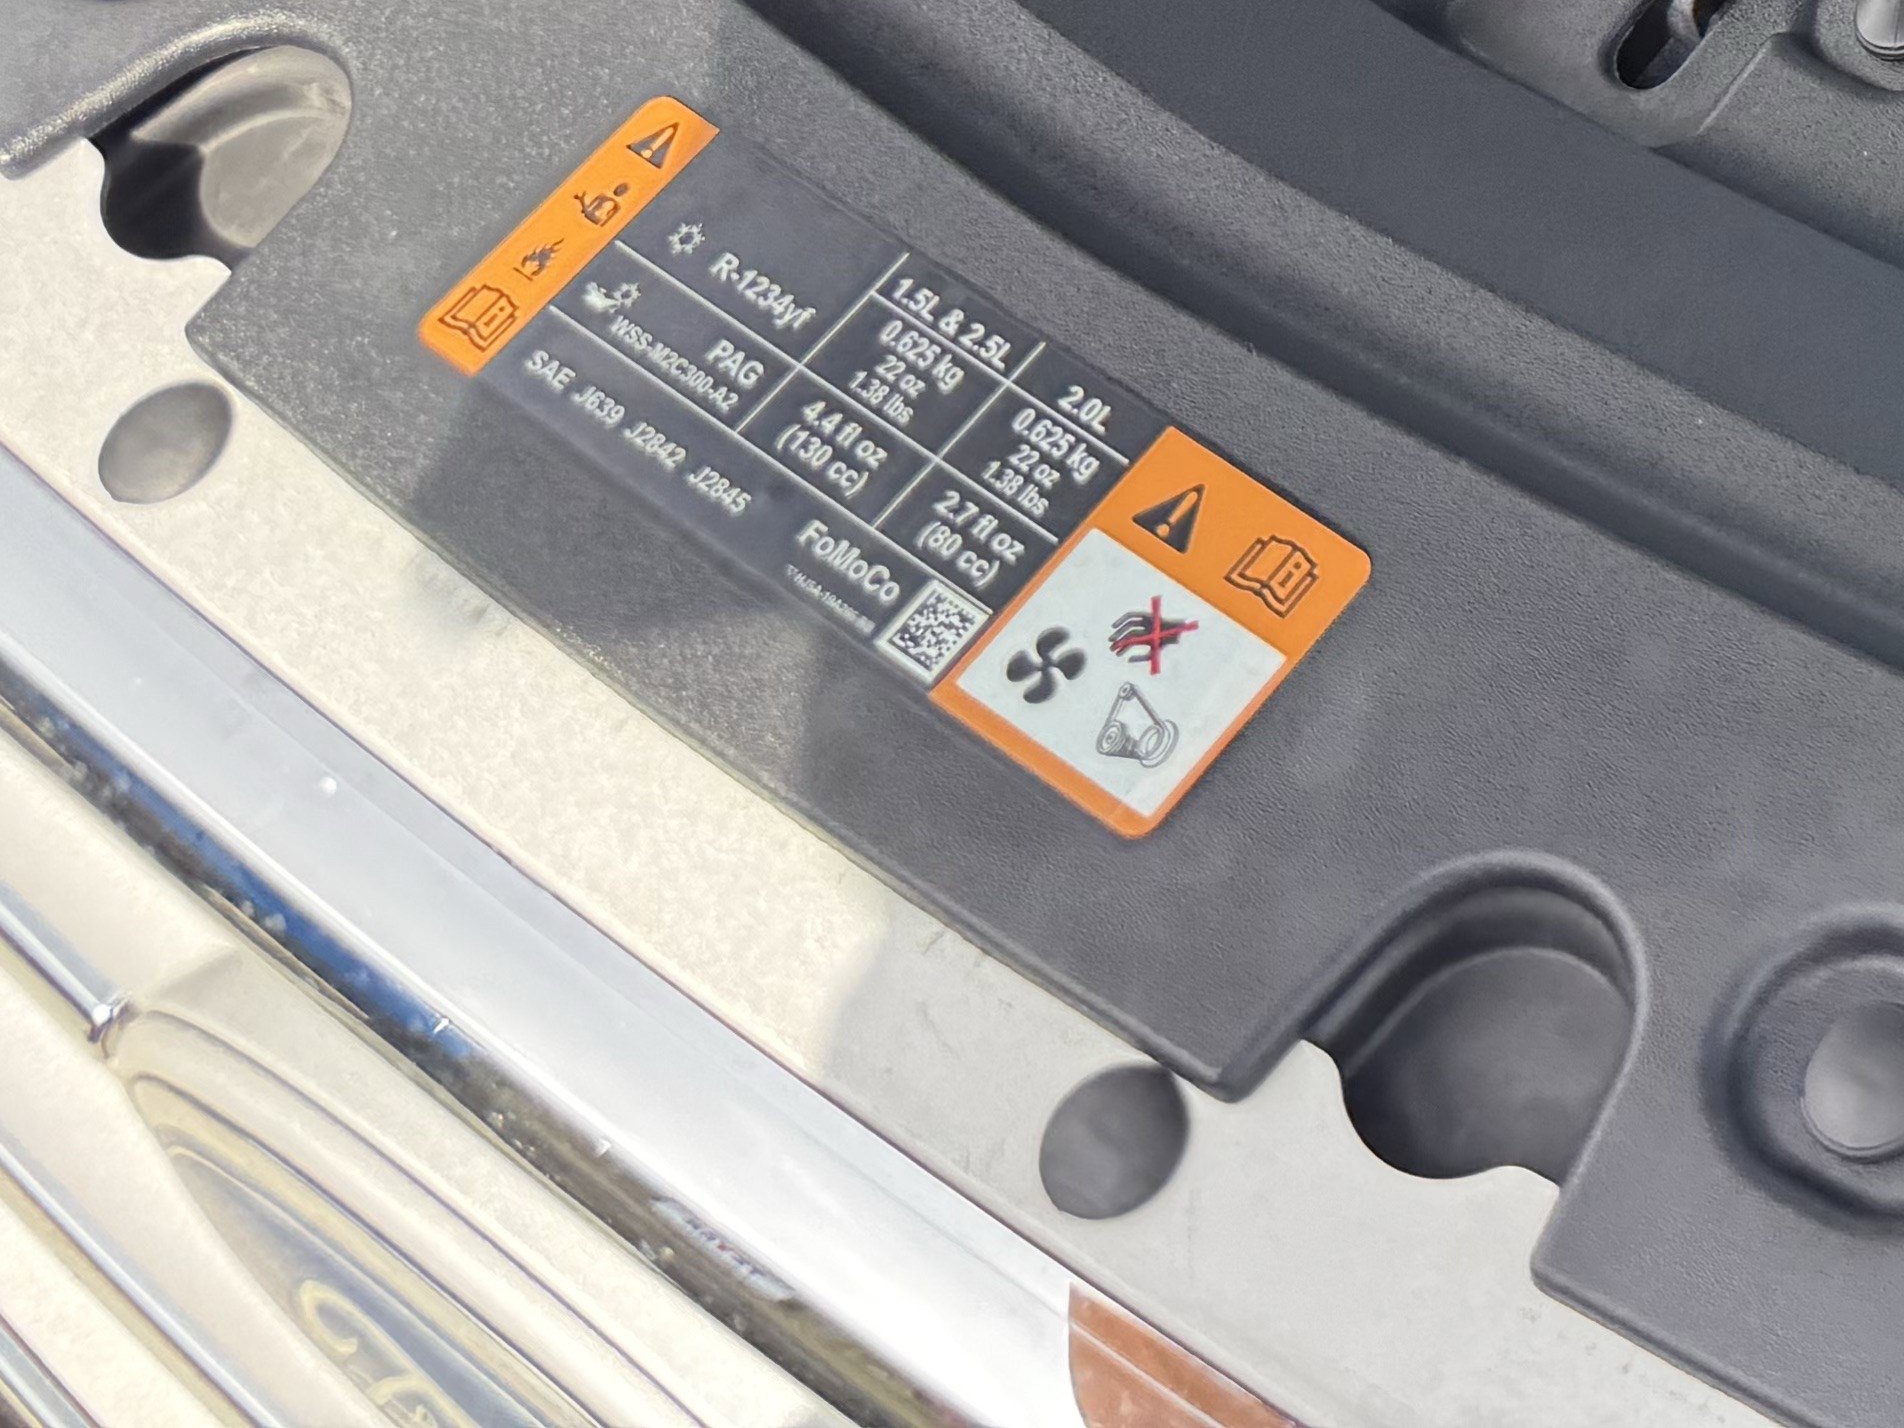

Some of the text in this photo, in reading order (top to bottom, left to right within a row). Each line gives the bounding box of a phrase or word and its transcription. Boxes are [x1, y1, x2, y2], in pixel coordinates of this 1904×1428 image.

[709, 251, 816, 331] R-1234yf
[892, 277, 1013, 371] 1.5L & 2.5L
[609, 315, 740, 415] WSS-M2C300-A2
[705, 339, 765, 389] PAG
[875, 354, 927, 400] 22 oz
[878, 319, 966, 394] 0.625 kg
[524, 349, 752, 515] SAE J639 J2842 J2845
[801, 399, 889, 470] 4.4 fl oz
[848, 370, 916, 427] 1.38 lbs
[1056, 384, 1112, 436] 2.0L
[775, 423, 870, 497] (130 cc)
[1008, 444, 1062, 490] 22 oz
[1010, 407, 1101, 486] 0.625 kg
[981, 460, 1051, 518] 1.38 lbs
[796, 518, 902, 606] FoMoCo
[916, 520, 1001, 591] (80 cc)
[934, 490, 1026, 567] 2.7 fl oz
